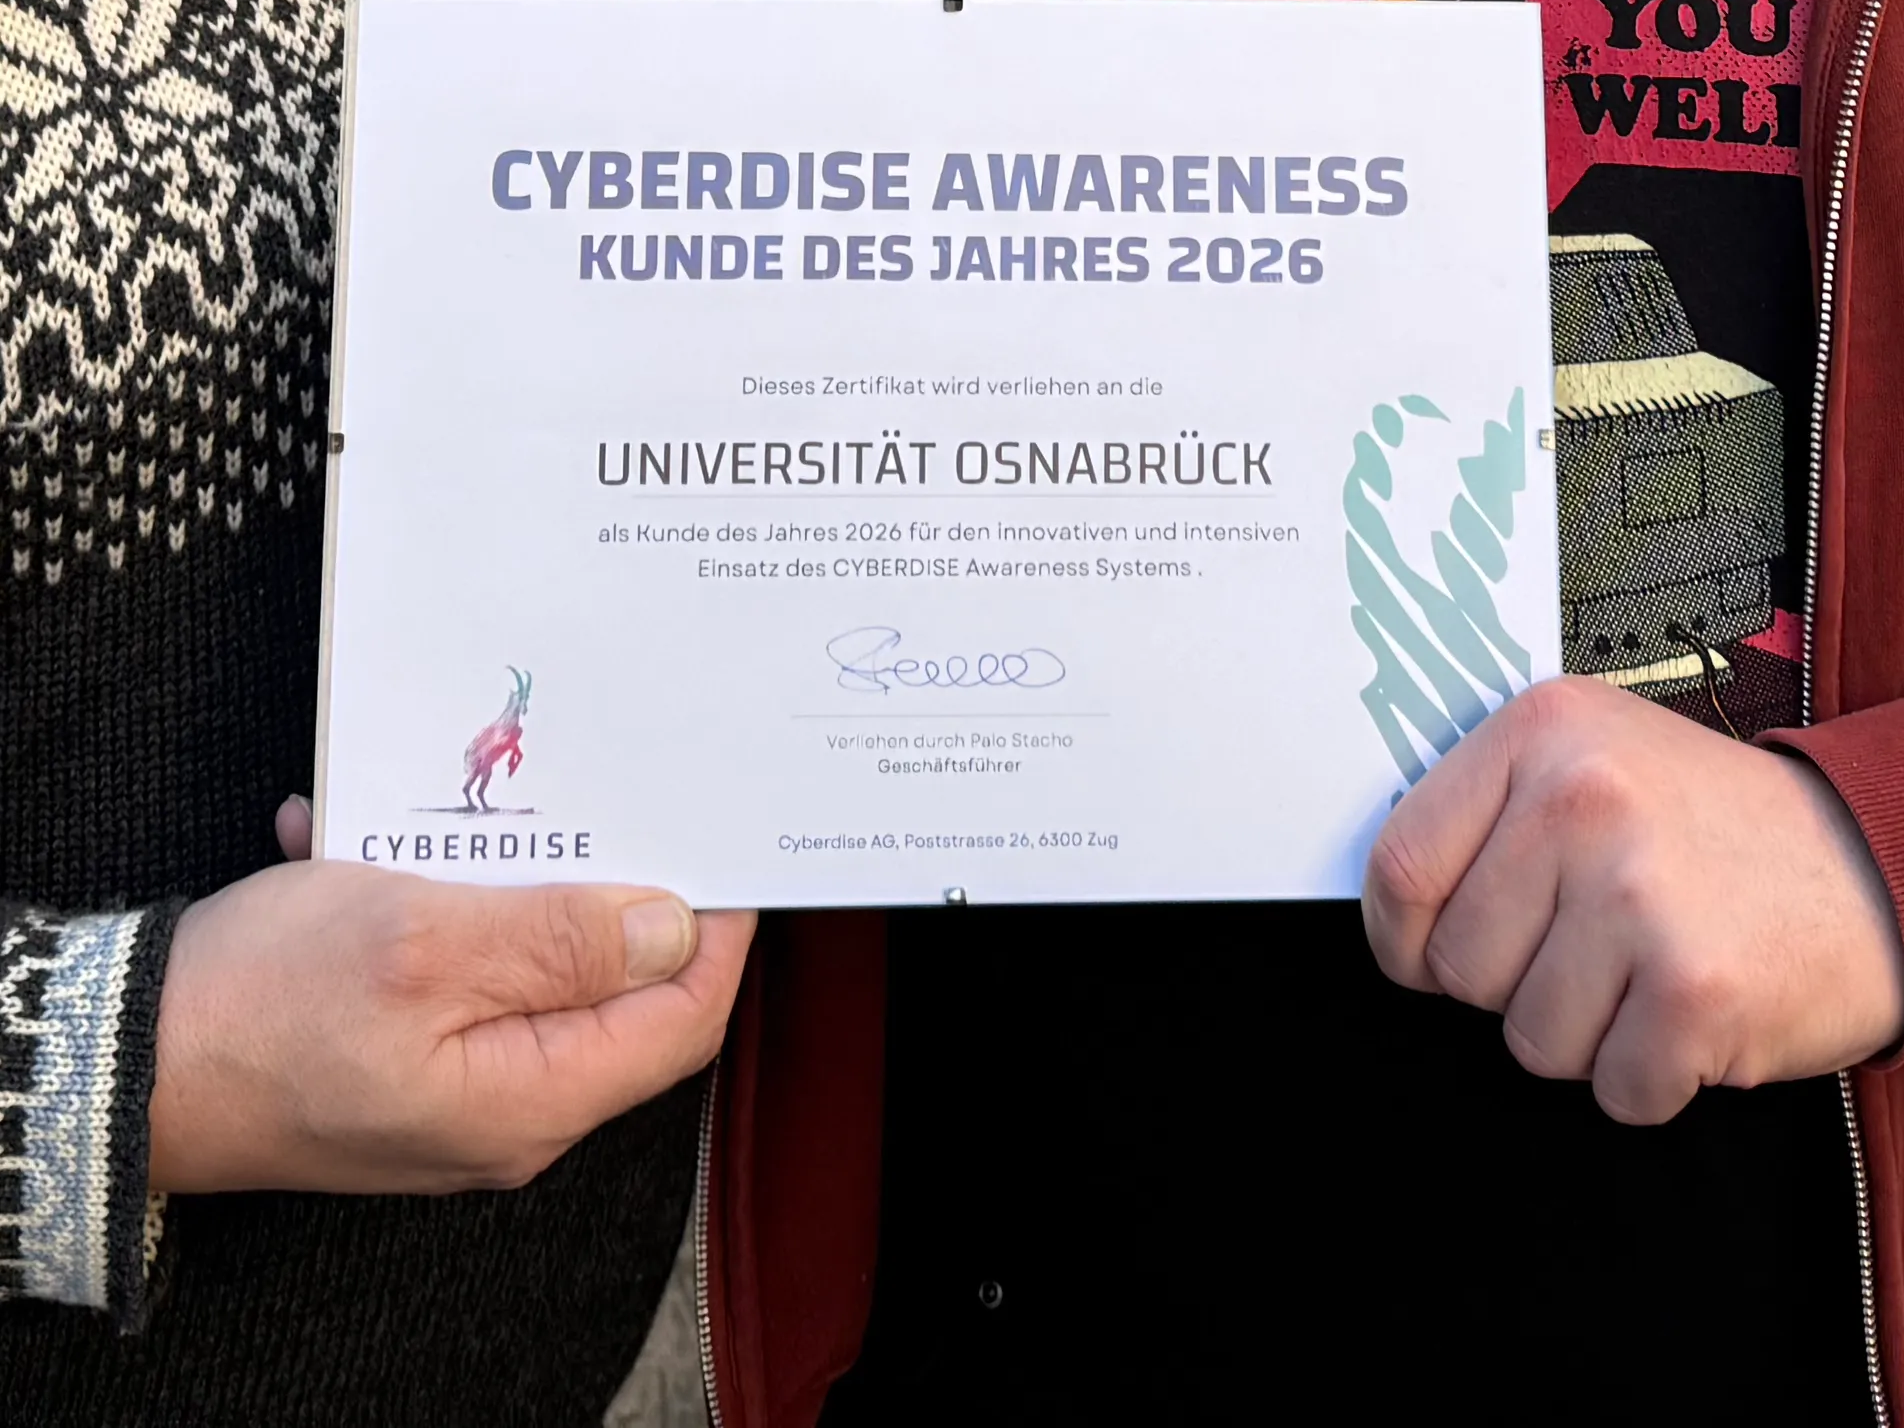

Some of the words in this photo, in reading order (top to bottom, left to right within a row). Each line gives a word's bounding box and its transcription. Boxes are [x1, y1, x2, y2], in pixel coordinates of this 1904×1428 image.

[491, 148, 911, 212] CYBERDISE
[931, 152, 1409, 218] AWARENESS
[578, 234, 784, 282] KUNDE
[802, 234, 914, 282] DES
[929, 235, 1150, 284] JAHRES
[1167, 236, 1324, 285] 2026
[742, 375, 816, 396] Dieses
[822, 375, 926, 396] Zertifikat
[931, 375, 980, 396] wird
[986, 375, 1090, 396] verliehen
[1096, 380, 1123, 396] an
[1129, 376, 1164, 396] die
[598, 428, 937, 487] UNIVERSITÄT
[955, 429, 1273, 486] OSNABRÜCK
[597, 522, 630, 544] als
[636, 522, 710, 544] Kunde
[716, 521, 758, 543] des
[763, 522, 839, 543] Jahres
[845, 521, 902, 543] 2026
[909, 520, 942, 542] für
[947, 521, 991, 542] den
[997, 521, 1128, 542] innovativen
[1134, 520, 1177, 542] und
[1184, 521, 1300, 542] intensiven
[697, 557, 780, 579] Einsatz
[785, 557, 827, 578] des
[832, 557, 960, 578] CYBERDISE
[965, 557, 1090, 578] Awareness
[1095, 557, 1192, 582] Systems
[826, 733, 909, 750] Verliehen
[913, 732, 965, 749] durch
[970, 732, 1007, 748] Palo
[1011, 732, 1074, 748] Stacho
[877, 756, 1022, 774] Geschäftsführer
[361, 832, 591, 862] CYBERDISE
[778, 833, 867, 854] Cyberdise
[870, 833, 900, 852] AG,
[904, 832, 1005, 851] Poststrasse
[1008, 832, 1035, 851] 26,
[1037, 831, 1083, 849] 6300
[1086, 831, 1119, 852] Zug
